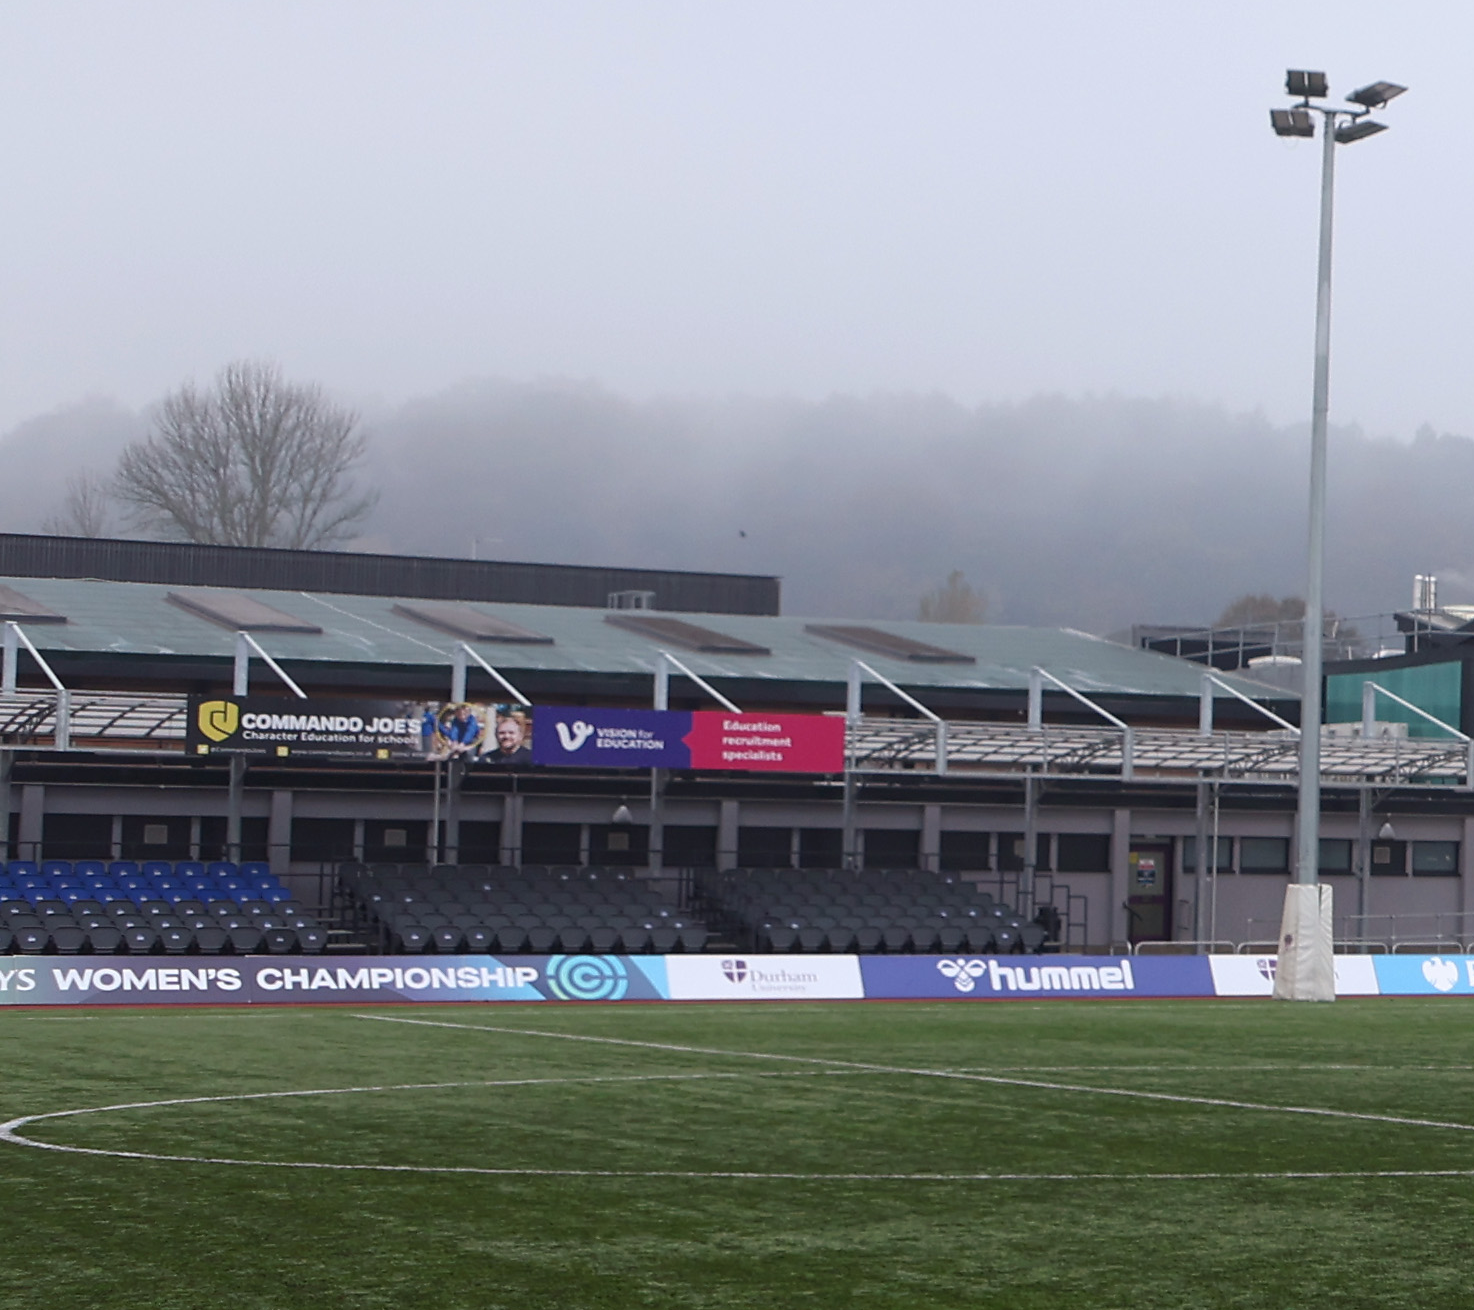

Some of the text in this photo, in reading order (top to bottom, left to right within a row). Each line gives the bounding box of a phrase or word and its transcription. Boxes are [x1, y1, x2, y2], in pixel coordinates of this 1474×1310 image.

[241, 713, 363, 732] COMMANDO
[723, 720, 781, 732] Education
[242, 731, 418, 745] Character Education for schools
[597, 727, 654, 739] VISION for
[596, 738, 664, 750] EDUCATION
[722, 735, 791, 747] recruitment
[722, 750, 782, 761] specialists
[52, 968, 242, 991] WOMEN'S
[256, 966, 539, 990] CHAMPIONSHIP
[750, 969, 818, 982] Durham
[988, 959, 1135, 991] hummel
